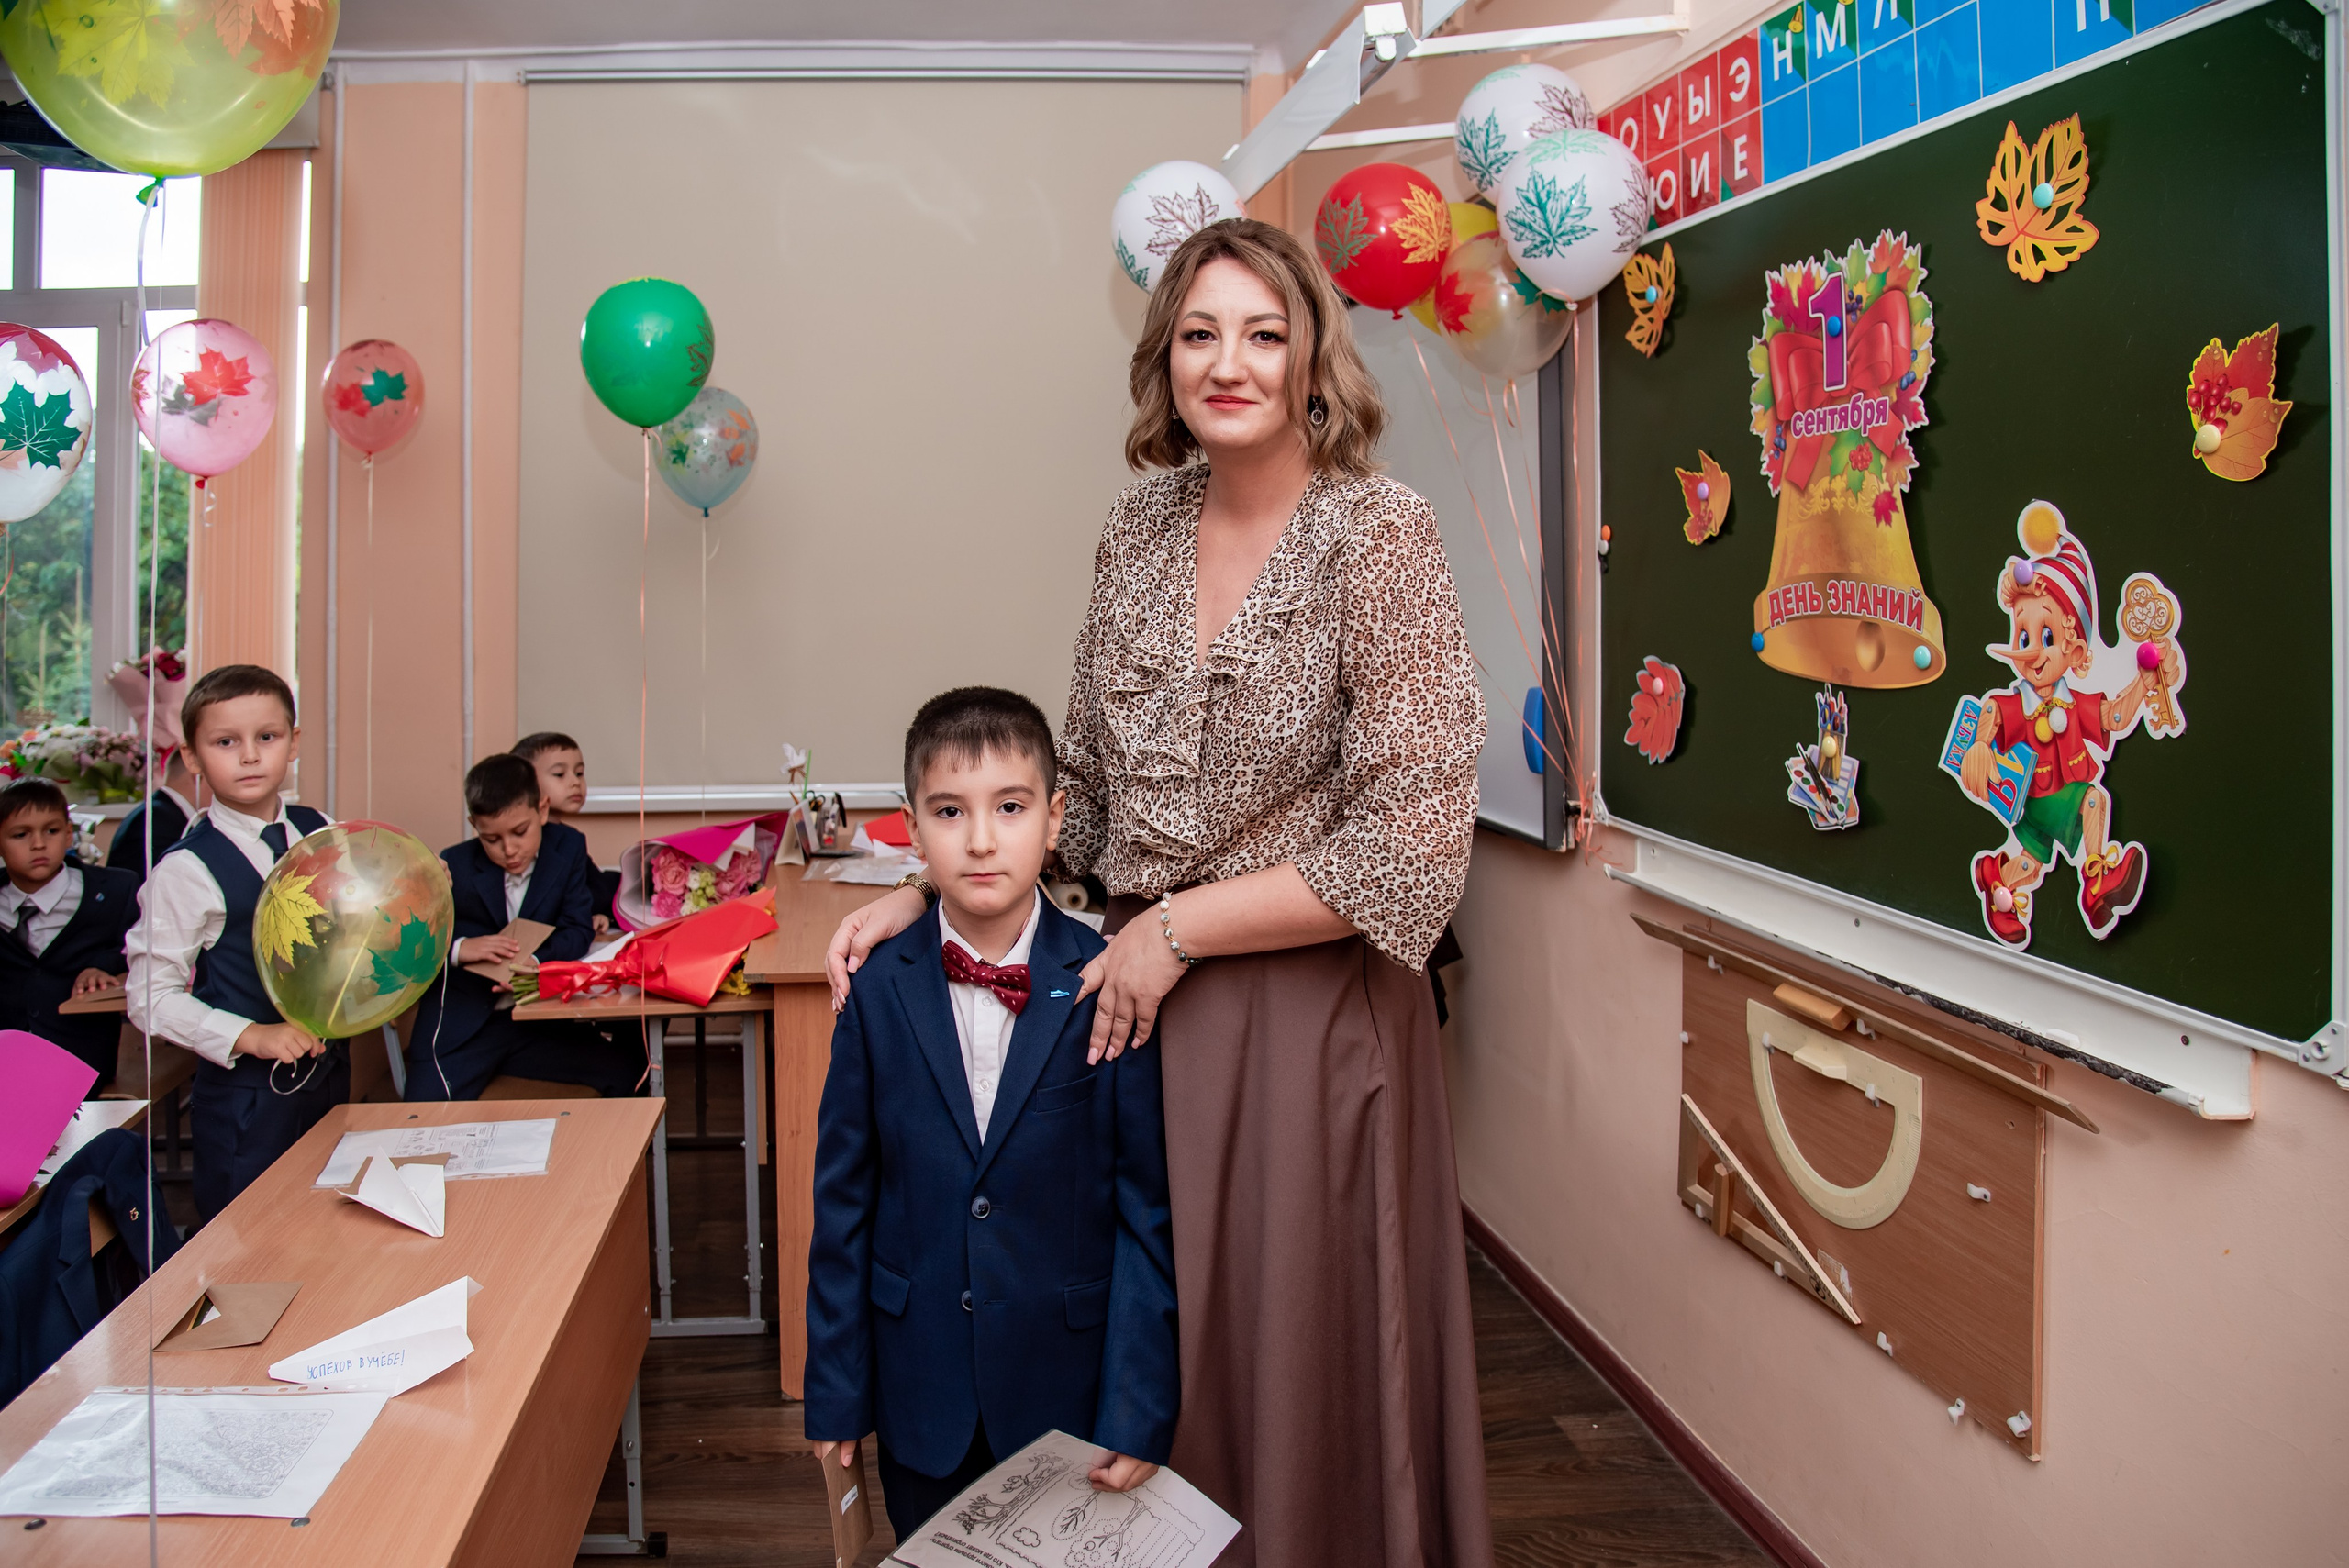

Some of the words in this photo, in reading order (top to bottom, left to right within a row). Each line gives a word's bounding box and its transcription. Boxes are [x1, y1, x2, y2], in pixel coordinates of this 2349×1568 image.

[1653, 96, 1672, 140] У
[1688, 74, 1710, 125] Ы
[1728, 56, 1751, 102] Э
[1772, 29, 1793, 82] Н
[1816, 2, 1846, 59] М
[1650, 169, 1676, 216] Ю
[1690, 151, 1710, 199] И
[1734, 134, 1749, 181] Е
[1809, 272, 1847, 391] 1
[1791, 393, 1889, 439] сентября
[1769, 581, 1823, 629] ДЕНЬ
[1827, 580, 1924, 633] ЗНАНИЙ
[1946, 706, 1978, 768] АЗБУКА
[307, 1360, 352, 1380] УСПЕХОВ
